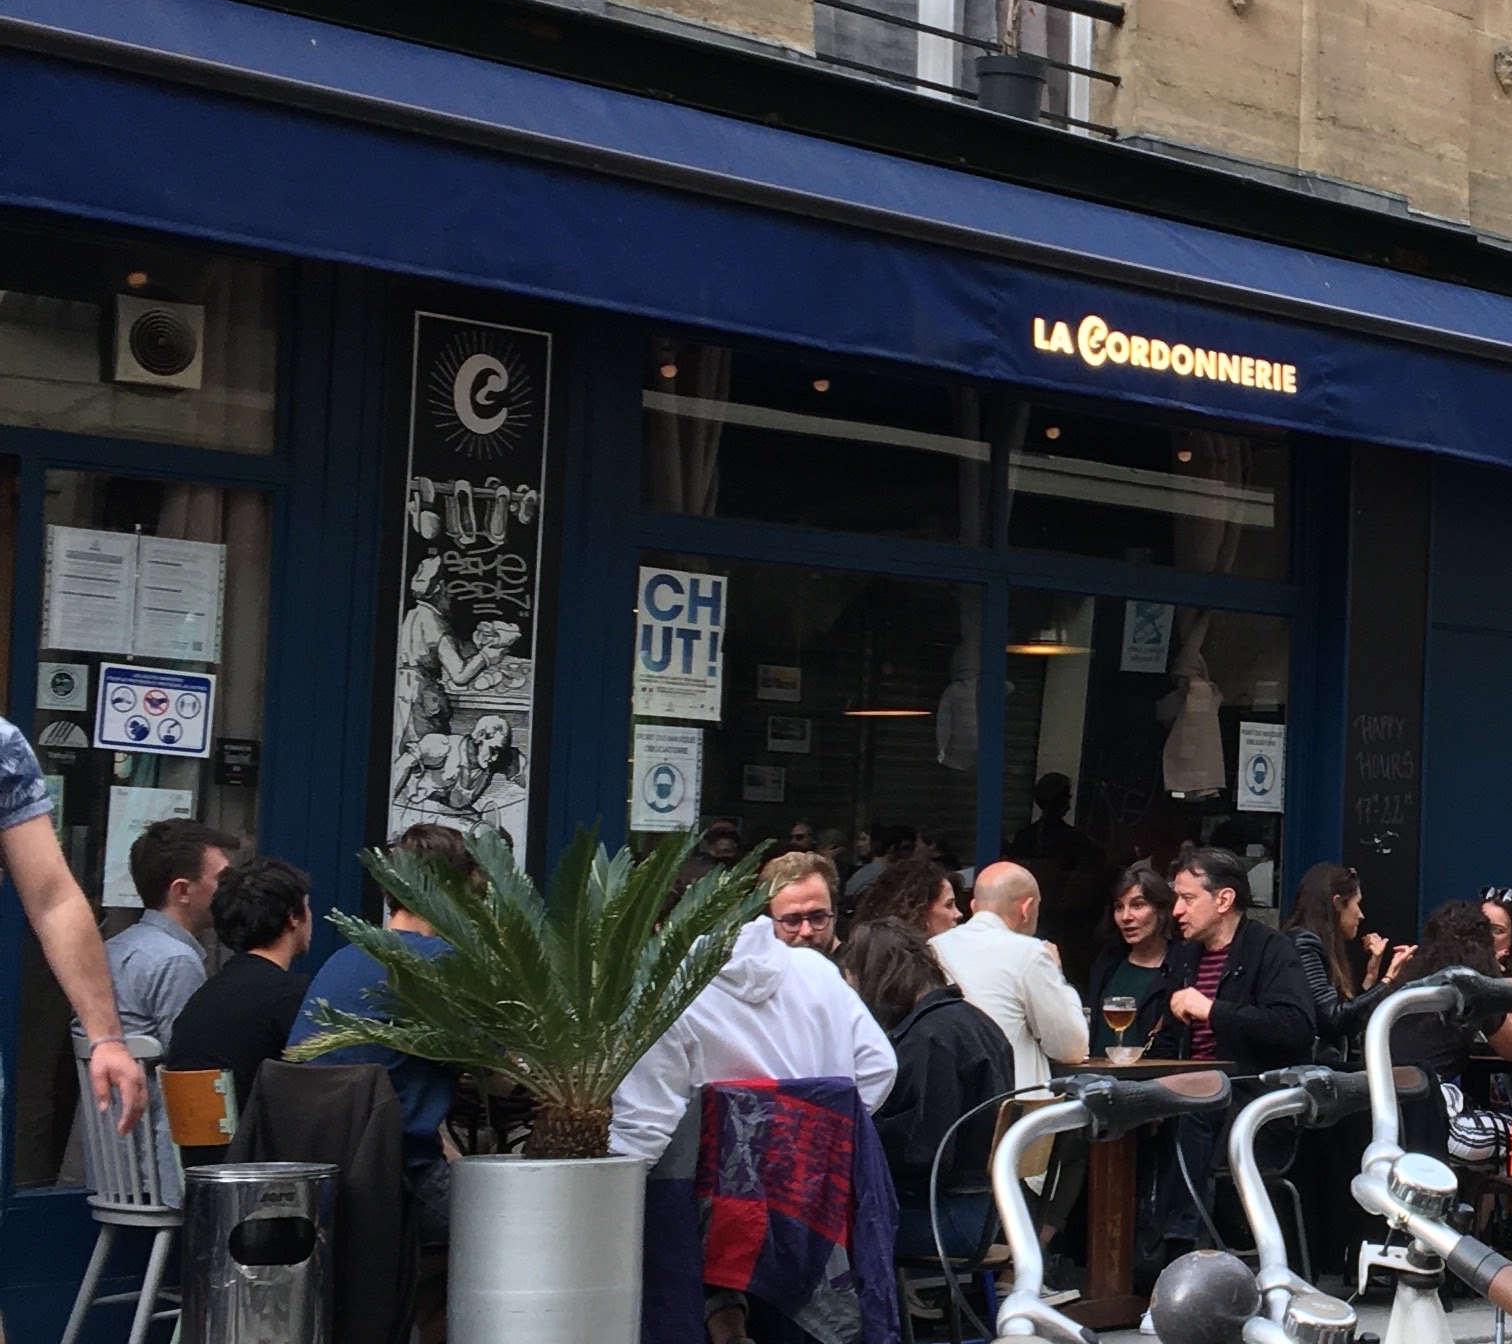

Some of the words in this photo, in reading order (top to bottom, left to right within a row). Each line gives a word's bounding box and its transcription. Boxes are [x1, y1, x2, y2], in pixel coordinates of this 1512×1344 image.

[1034, 317, 1074, 354] LA
[1077, 314, 1297, 394] CORDONNERIE
[644, 573, 722, 626] CH
[640, 624, 719, 677] UT!
